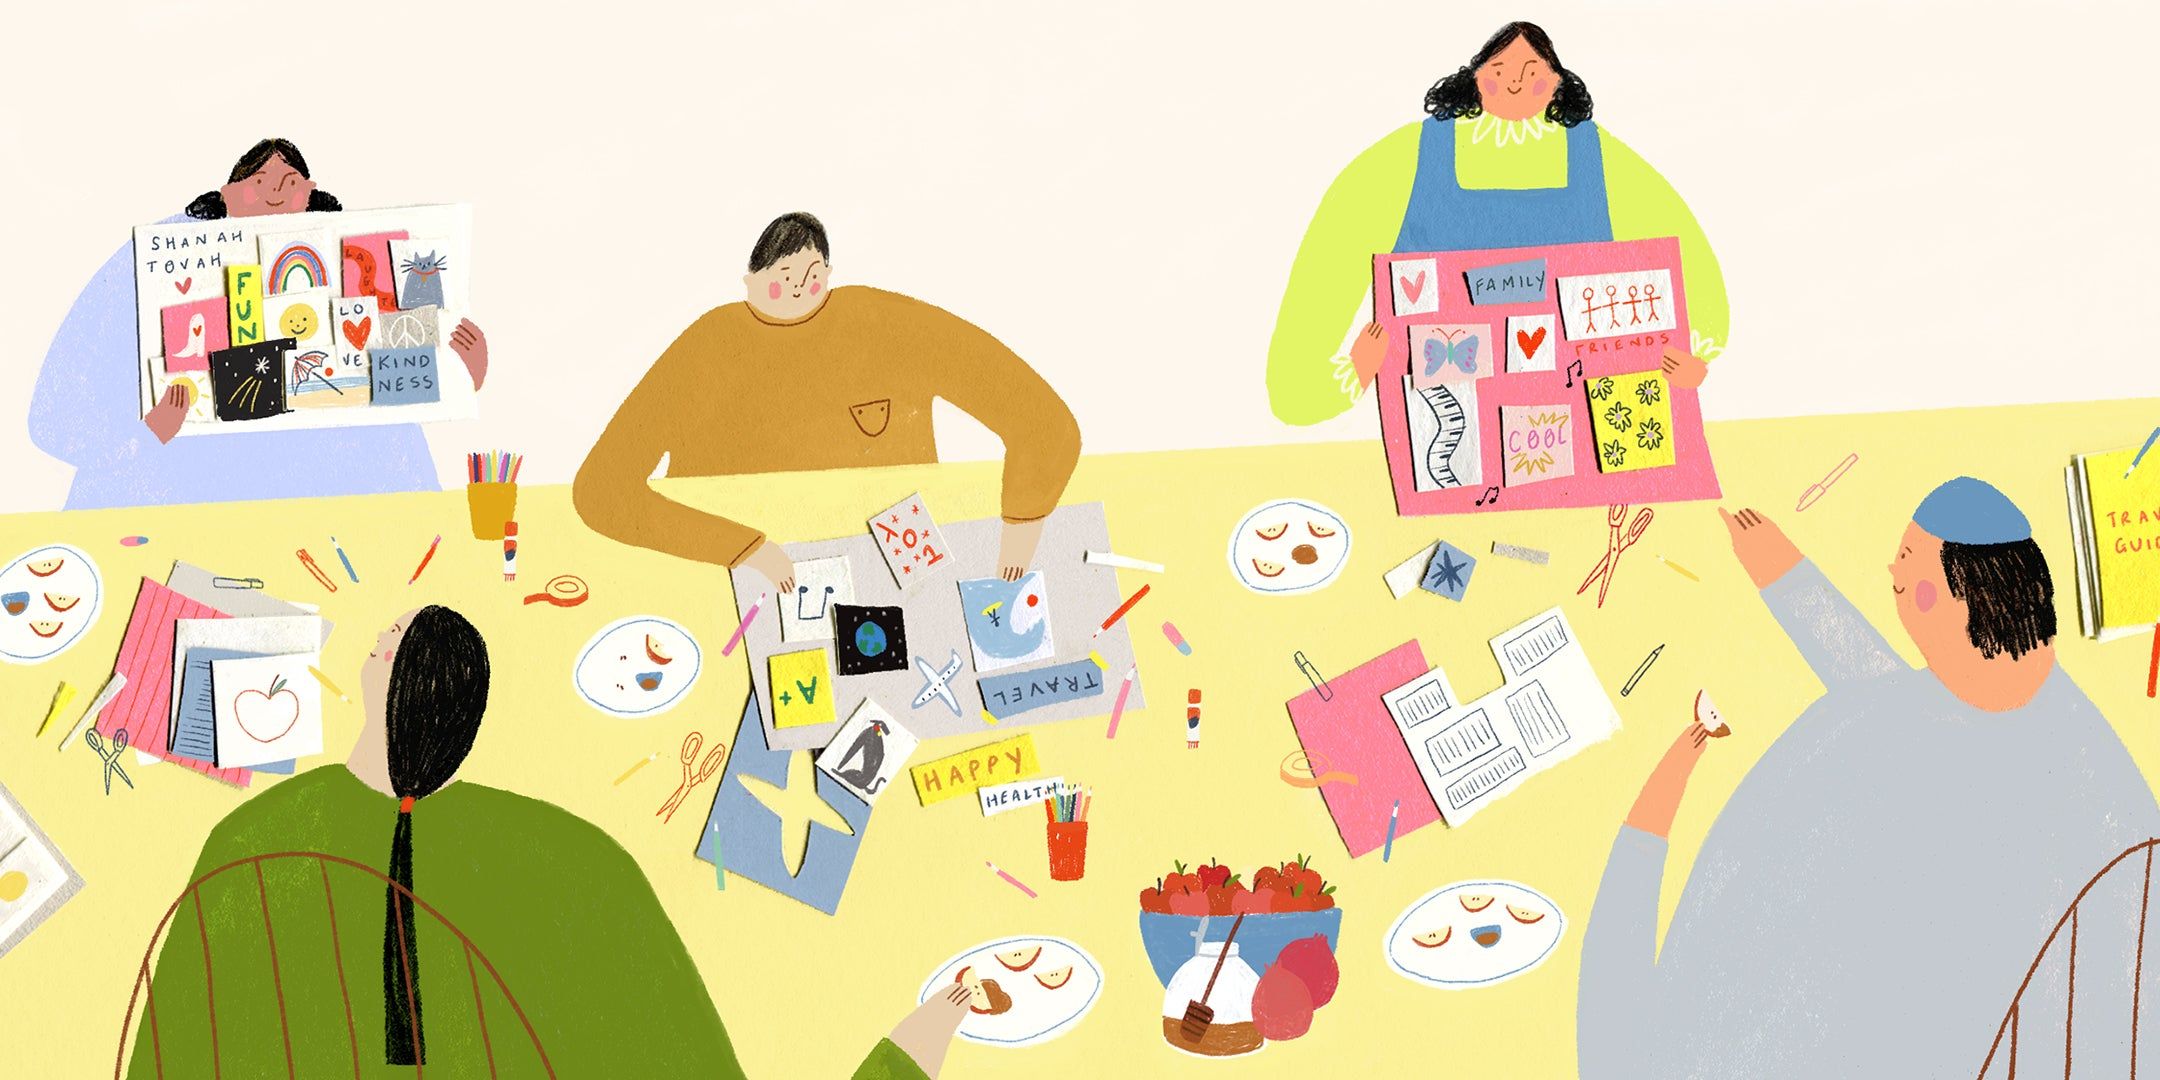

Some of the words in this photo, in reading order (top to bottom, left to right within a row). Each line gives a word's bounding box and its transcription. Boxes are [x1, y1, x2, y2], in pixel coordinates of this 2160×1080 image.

[151, 231, 243, 250] SHANAH
[146, 252, 222, 274] TOVAH
[1475, 270, 1546, 296] FAMILY
[237, 271, 257, 342] FUN
[1575, 332, 1670, 357] FRIENDS
[378, 355, 431, 371] KIND
[378, 376, 433, 393] NESS
[1508, 427, 1567, 453] COOL
[778, 675, 818, 706] A+
[993, 672, 1099, 704] TRAVEL
[923, 748, 1023, 793] HAPPY
[986, 781, 1058, 808] HEALTH
